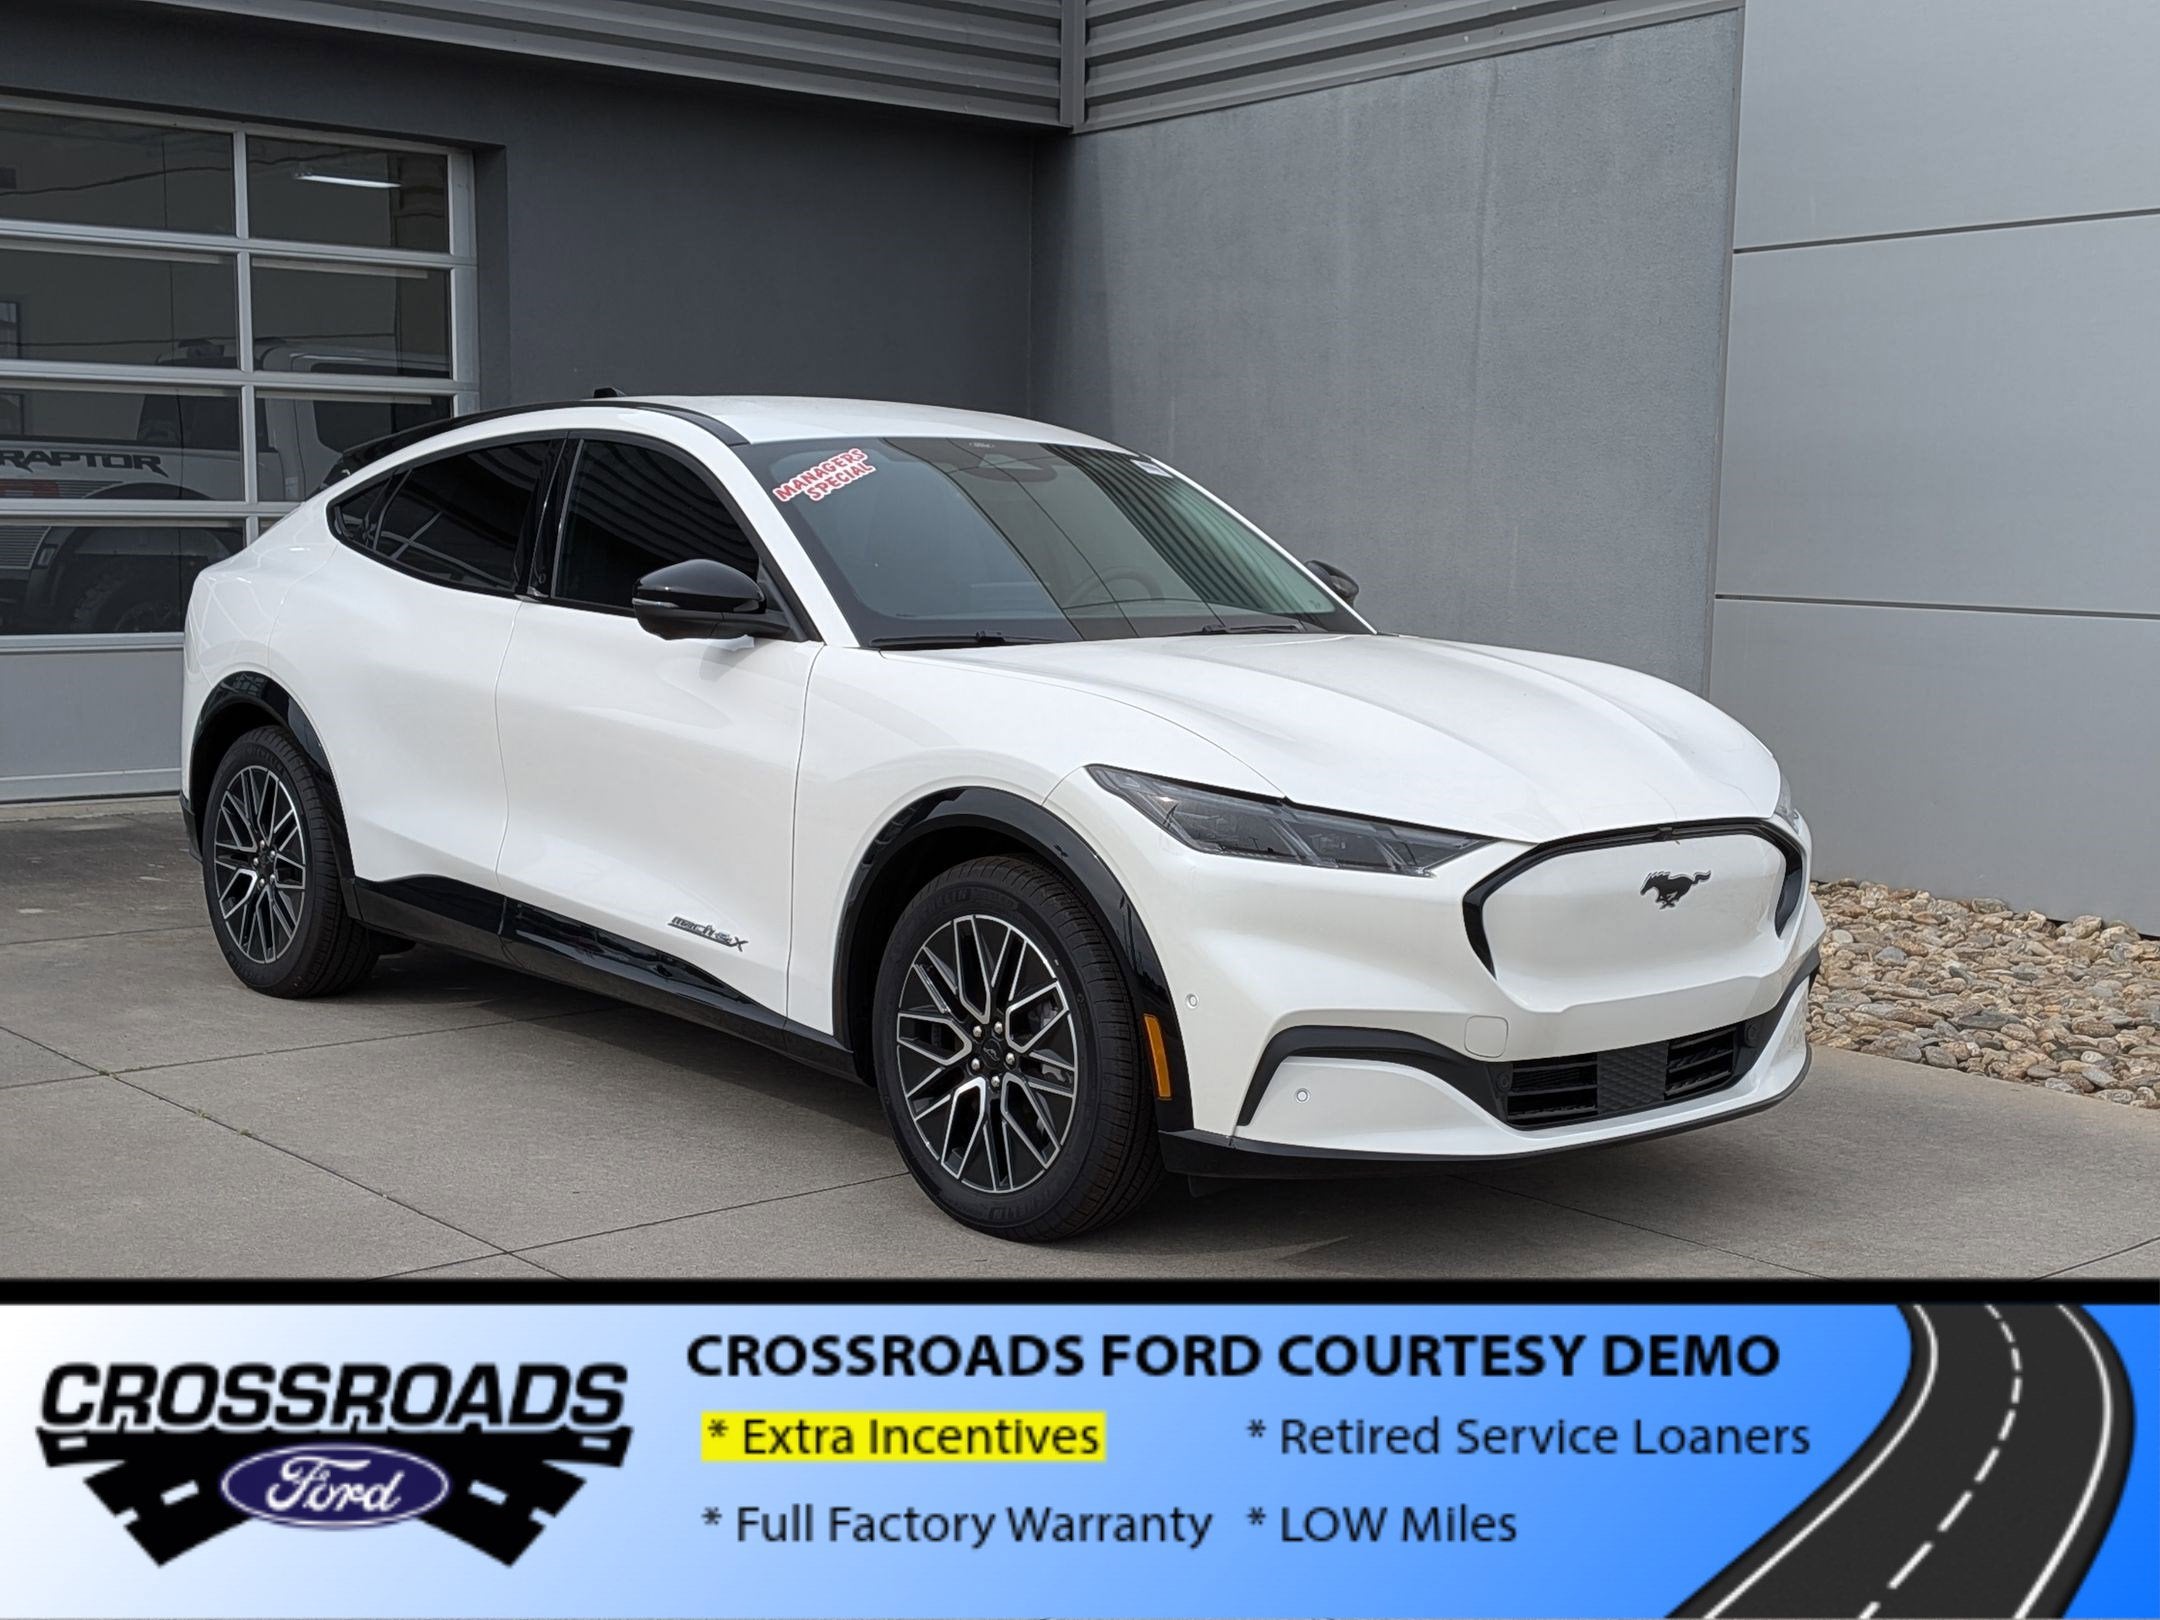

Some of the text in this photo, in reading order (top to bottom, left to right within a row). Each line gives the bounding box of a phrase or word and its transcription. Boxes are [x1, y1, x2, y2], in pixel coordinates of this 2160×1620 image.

[0, 450, 168, 478] RAPTOR
[774, 448, 866, 501] MANAGERS
[805, 462, 874, 500] SPECIAL
